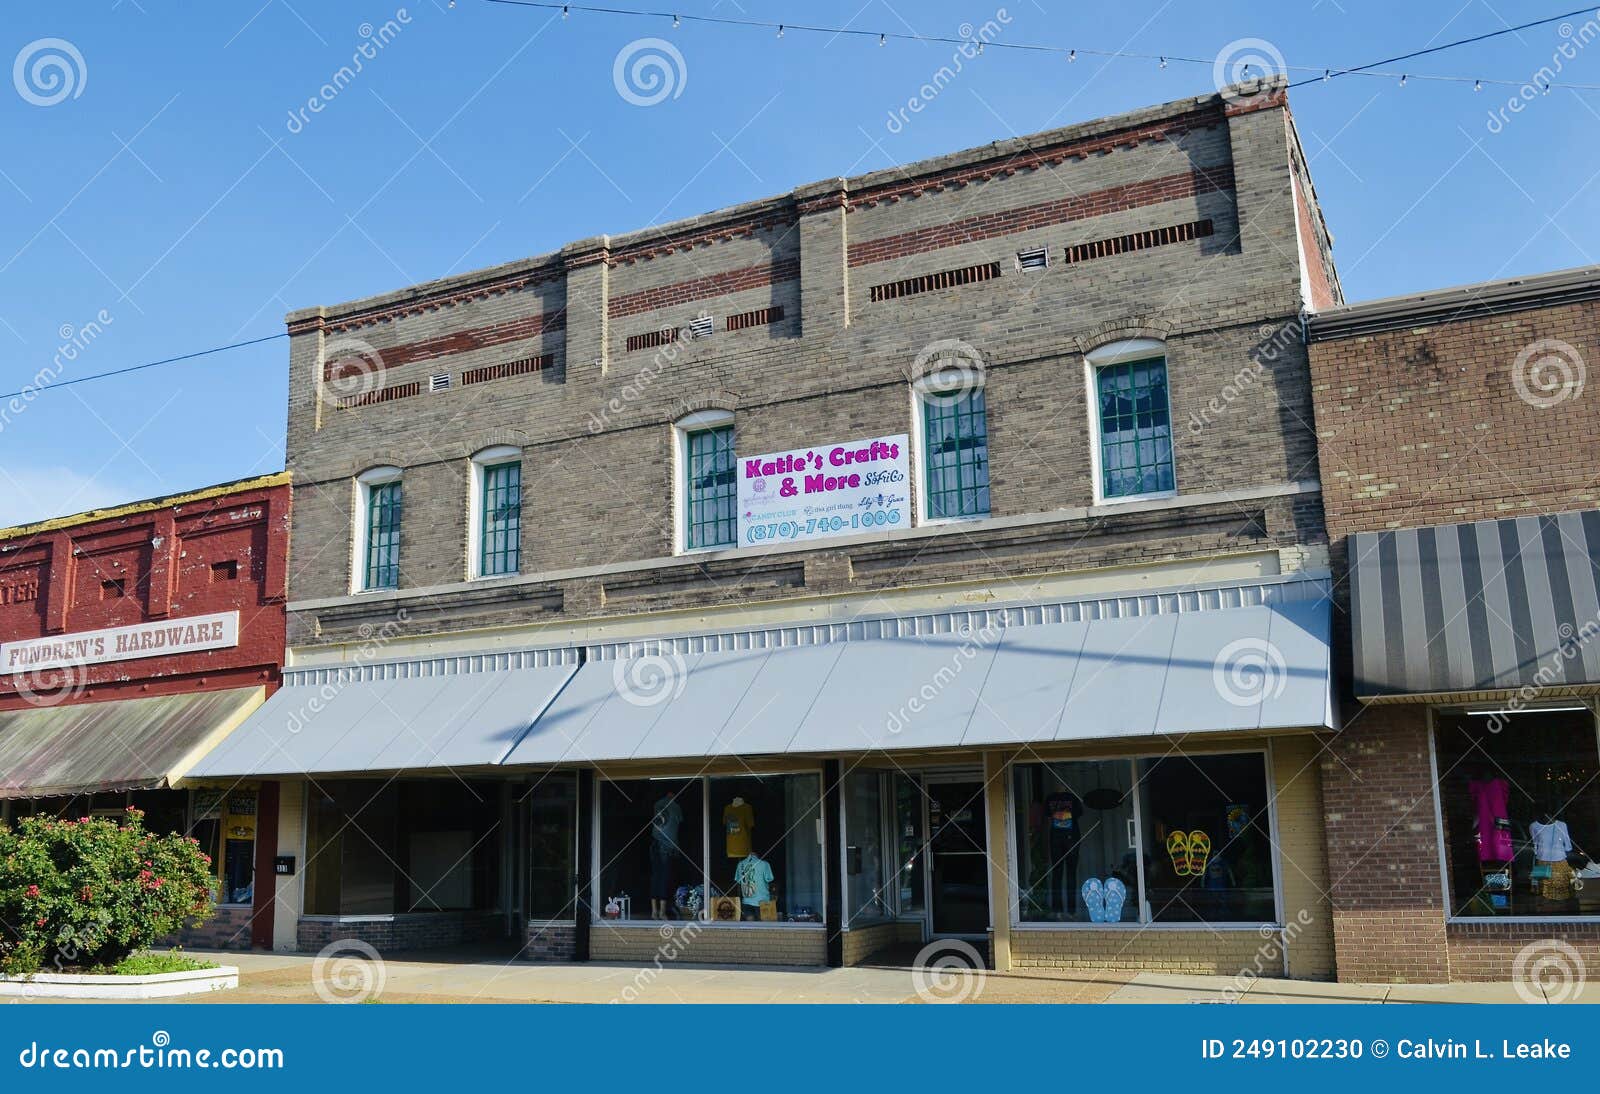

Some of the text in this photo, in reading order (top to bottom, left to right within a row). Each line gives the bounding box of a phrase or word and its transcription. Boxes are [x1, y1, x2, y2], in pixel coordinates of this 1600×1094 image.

[746, 441, 899, 478] Katie's Crafts
[780, 473, 861, 497] & More
[9, 621, 223, 666] FONDREN'S HARDWARE
